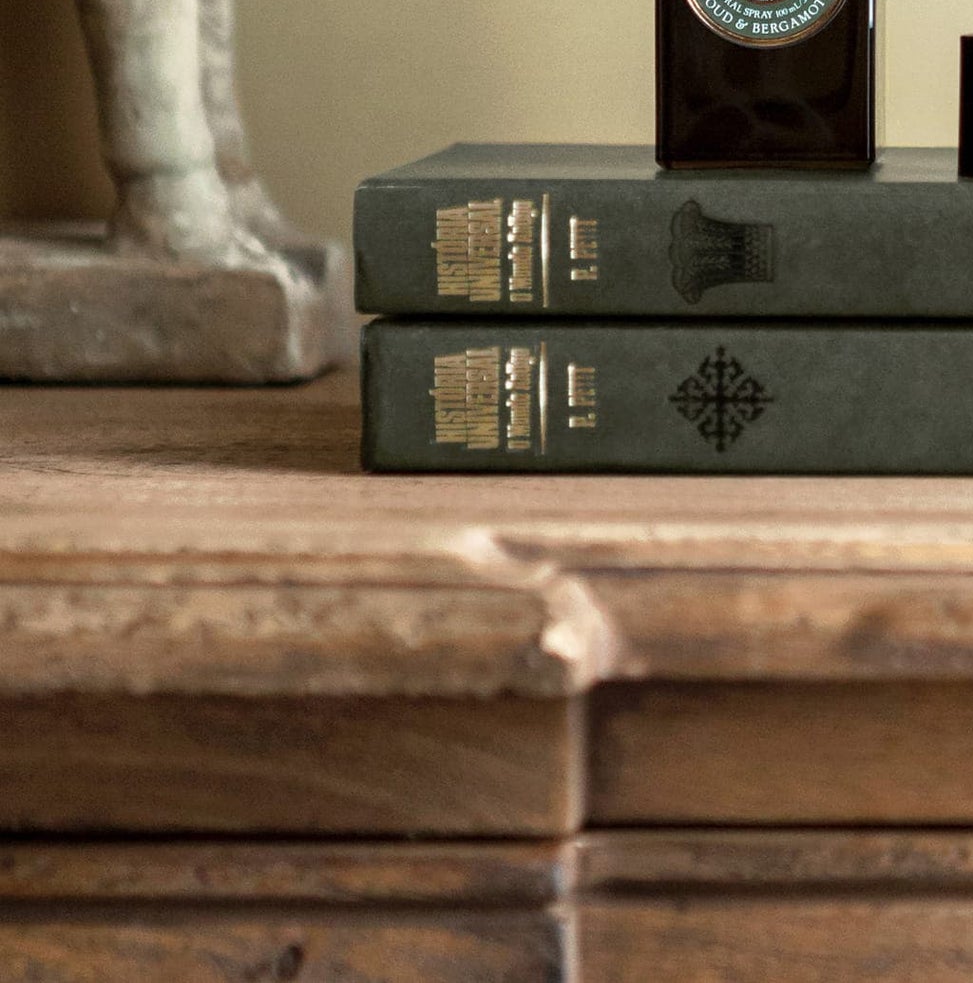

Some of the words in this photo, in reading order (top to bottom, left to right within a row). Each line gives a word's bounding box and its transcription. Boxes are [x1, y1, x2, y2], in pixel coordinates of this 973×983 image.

[736, 18, 748, 30] &
[743, 8, 773, 19] SPRAY
[431, 207, 468, 295] HISTÓRIA
[468, 199, 501, 302] UNIVERSAL
[429, 354, 466, 443] HISTÓRIA
[466, 346, 499, 449] UNIVERSAL
